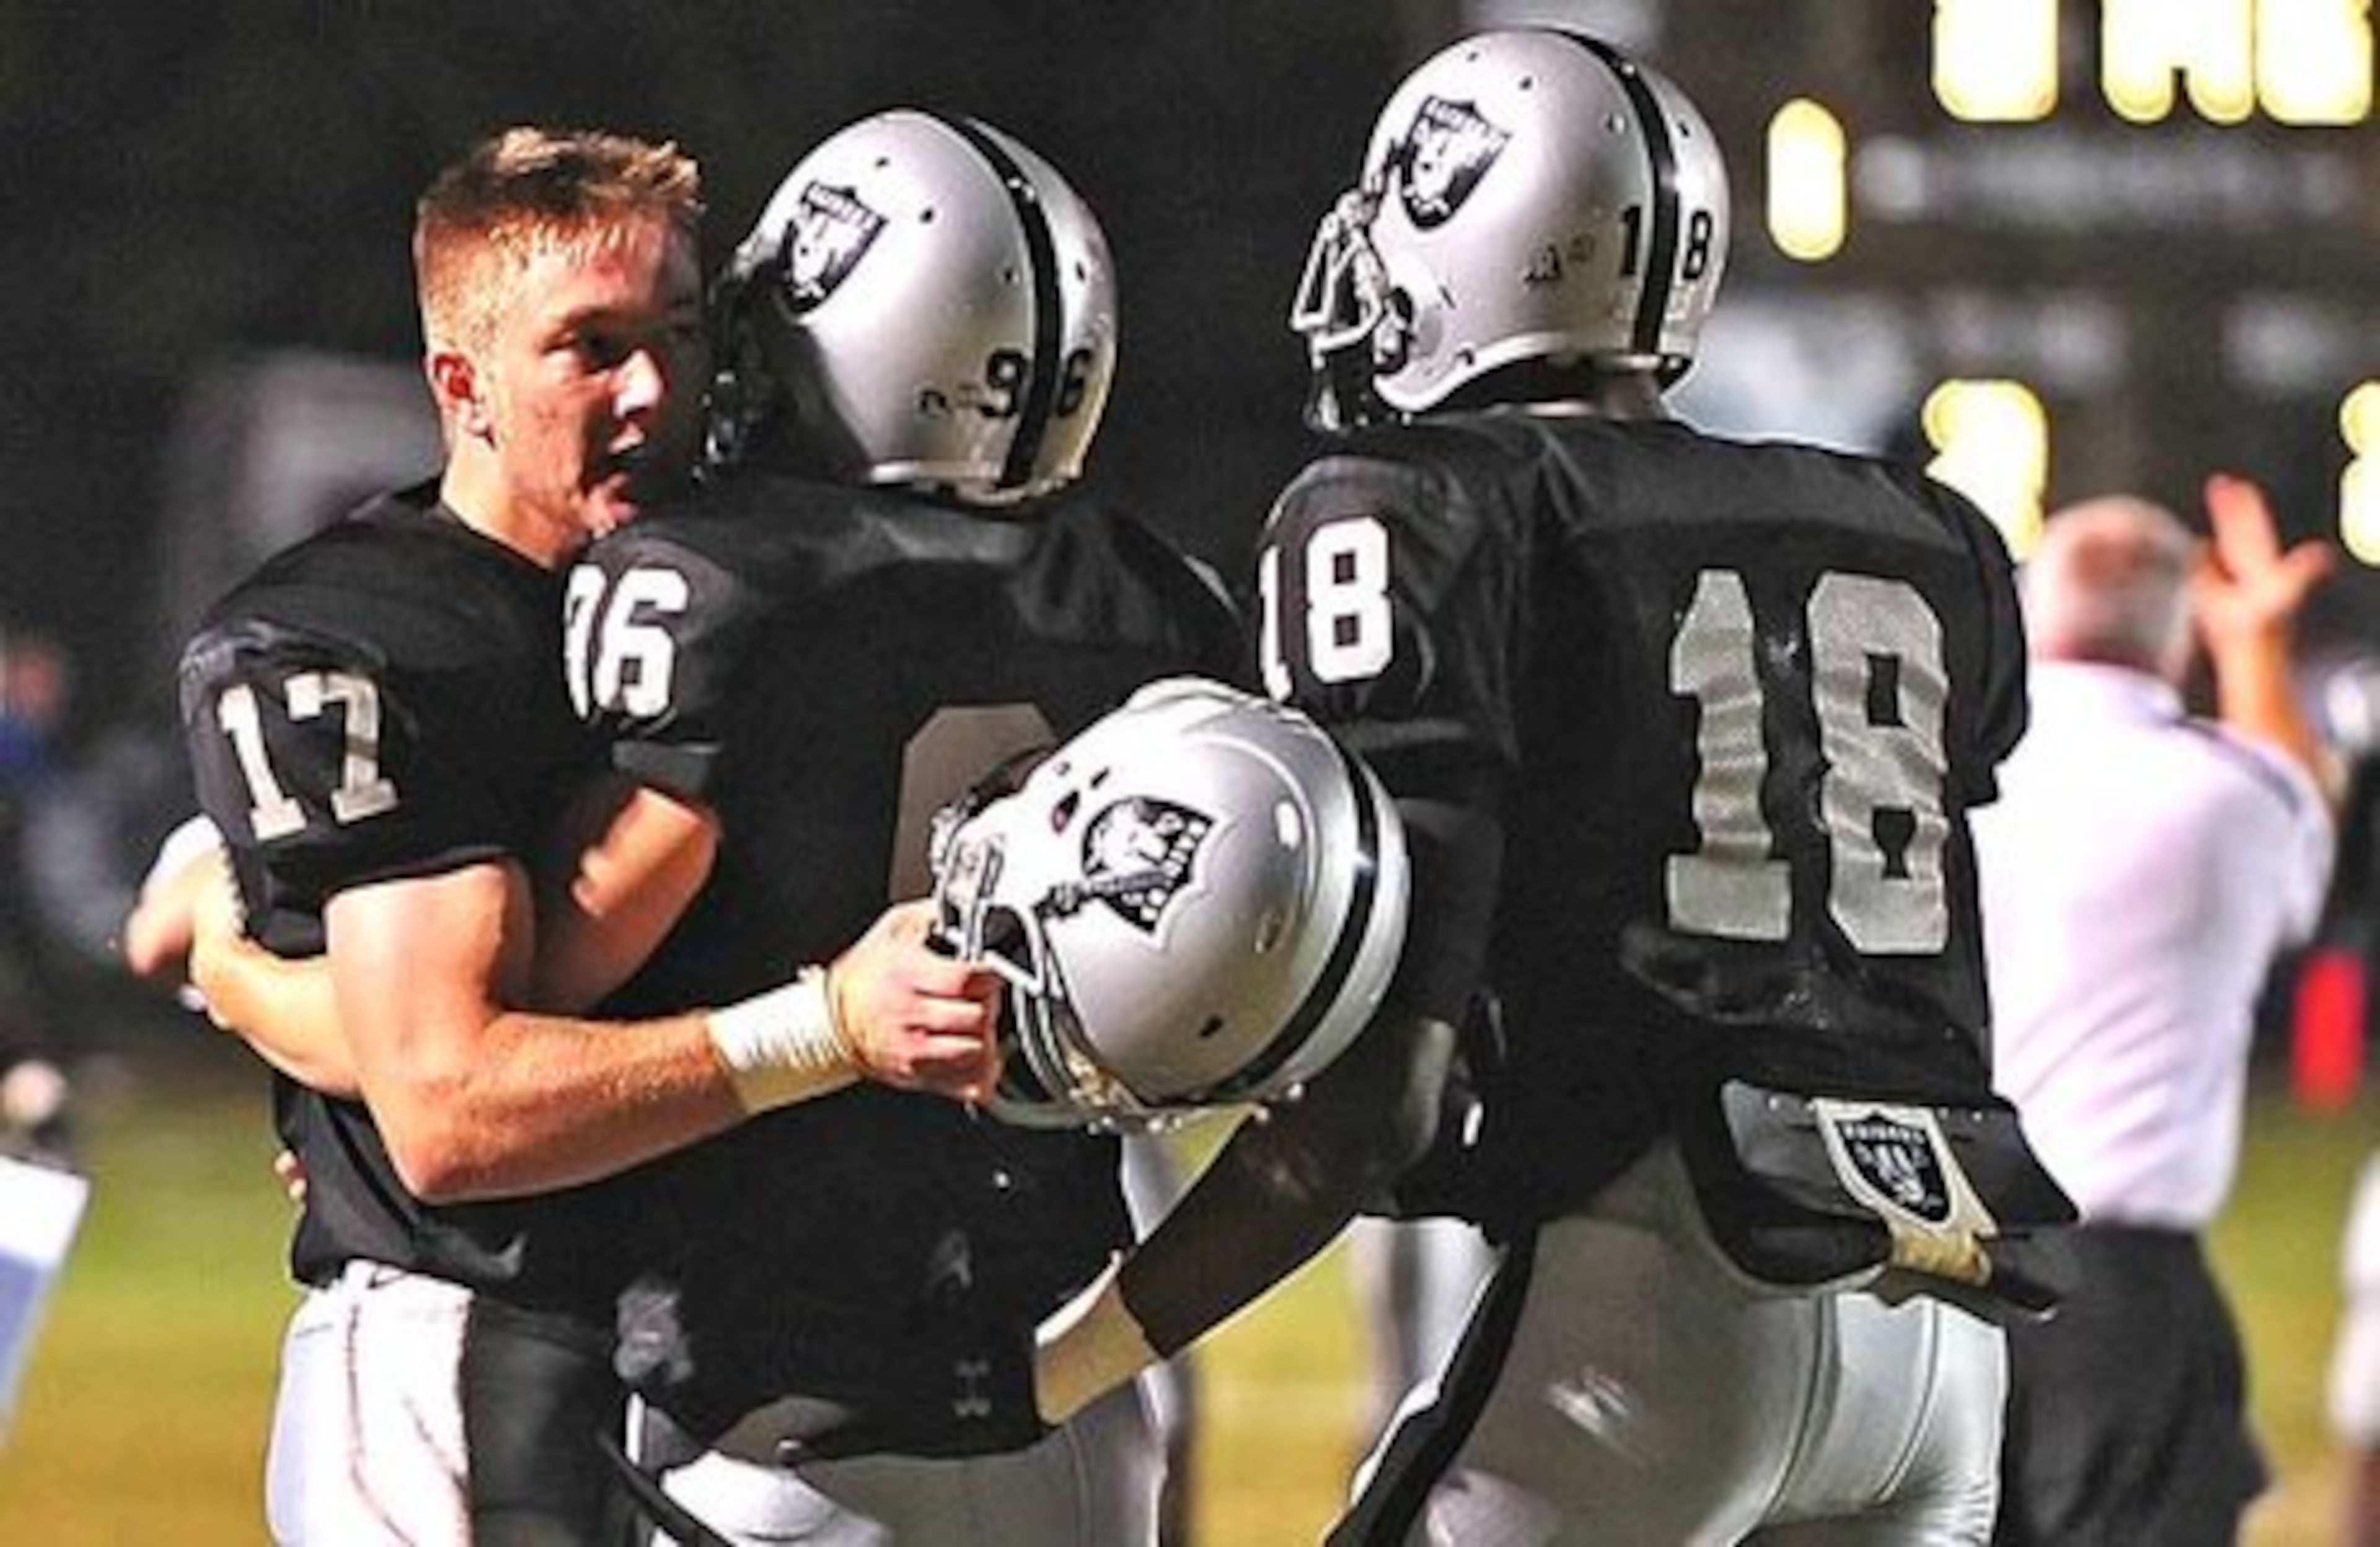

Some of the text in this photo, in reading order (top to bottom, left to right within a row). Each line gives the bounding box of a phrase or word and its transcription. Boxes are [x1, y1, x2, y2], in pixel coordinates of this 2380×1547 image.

[1259, 516, 1394, 701] 18
[218, 672, 398, 839] 17
[1668, 570, 1949, 952] 18
